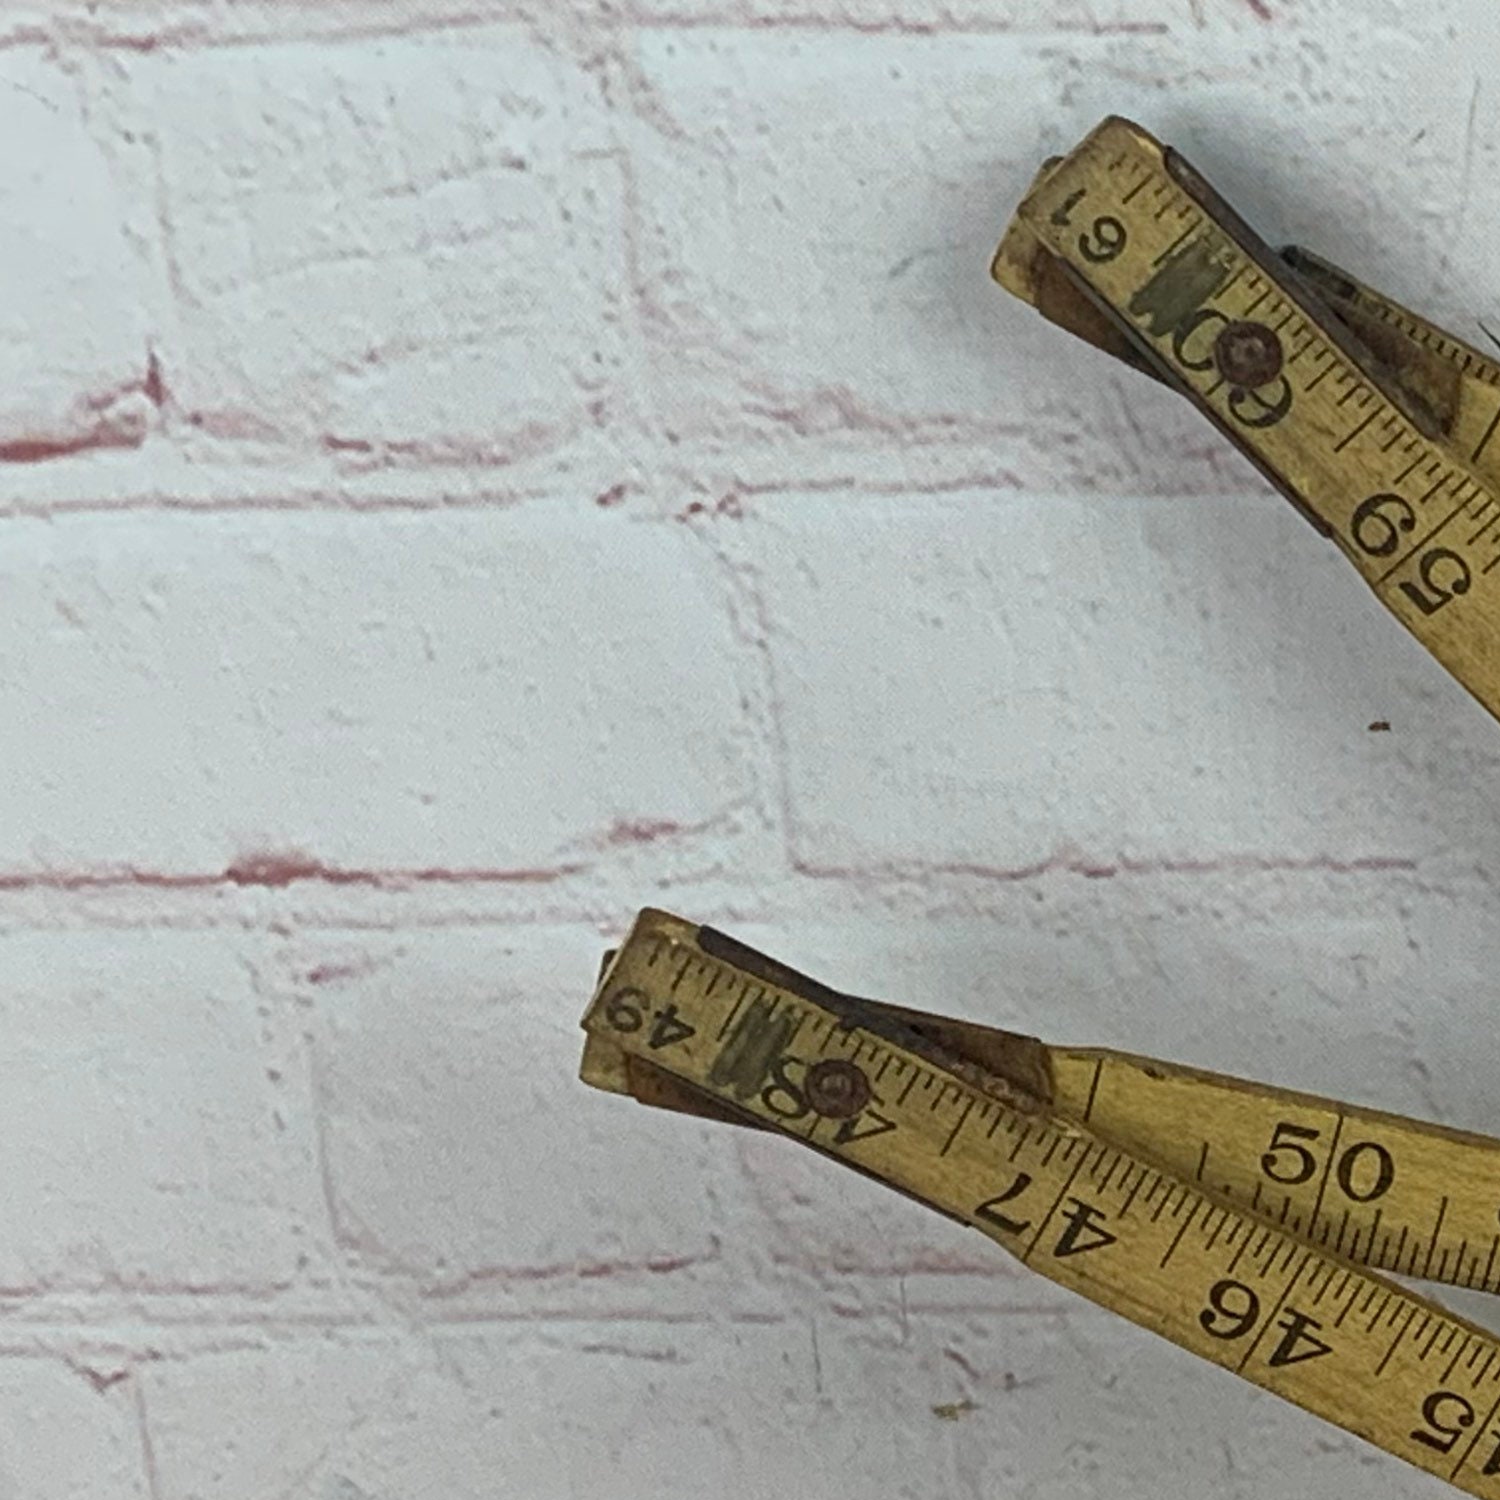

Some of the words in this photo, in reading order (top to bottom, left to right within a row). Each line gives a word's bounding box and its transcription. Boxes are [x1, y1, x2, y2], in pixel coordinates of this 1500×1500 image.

[1350, 492, 1472, 617] 59
[604, 985, 696, 1051] 49
[1260, 1122, 1394, 1202] 50
[976, 1173, 1118, 1258] 47
[1199, 1278, 1334, 1369] 46
